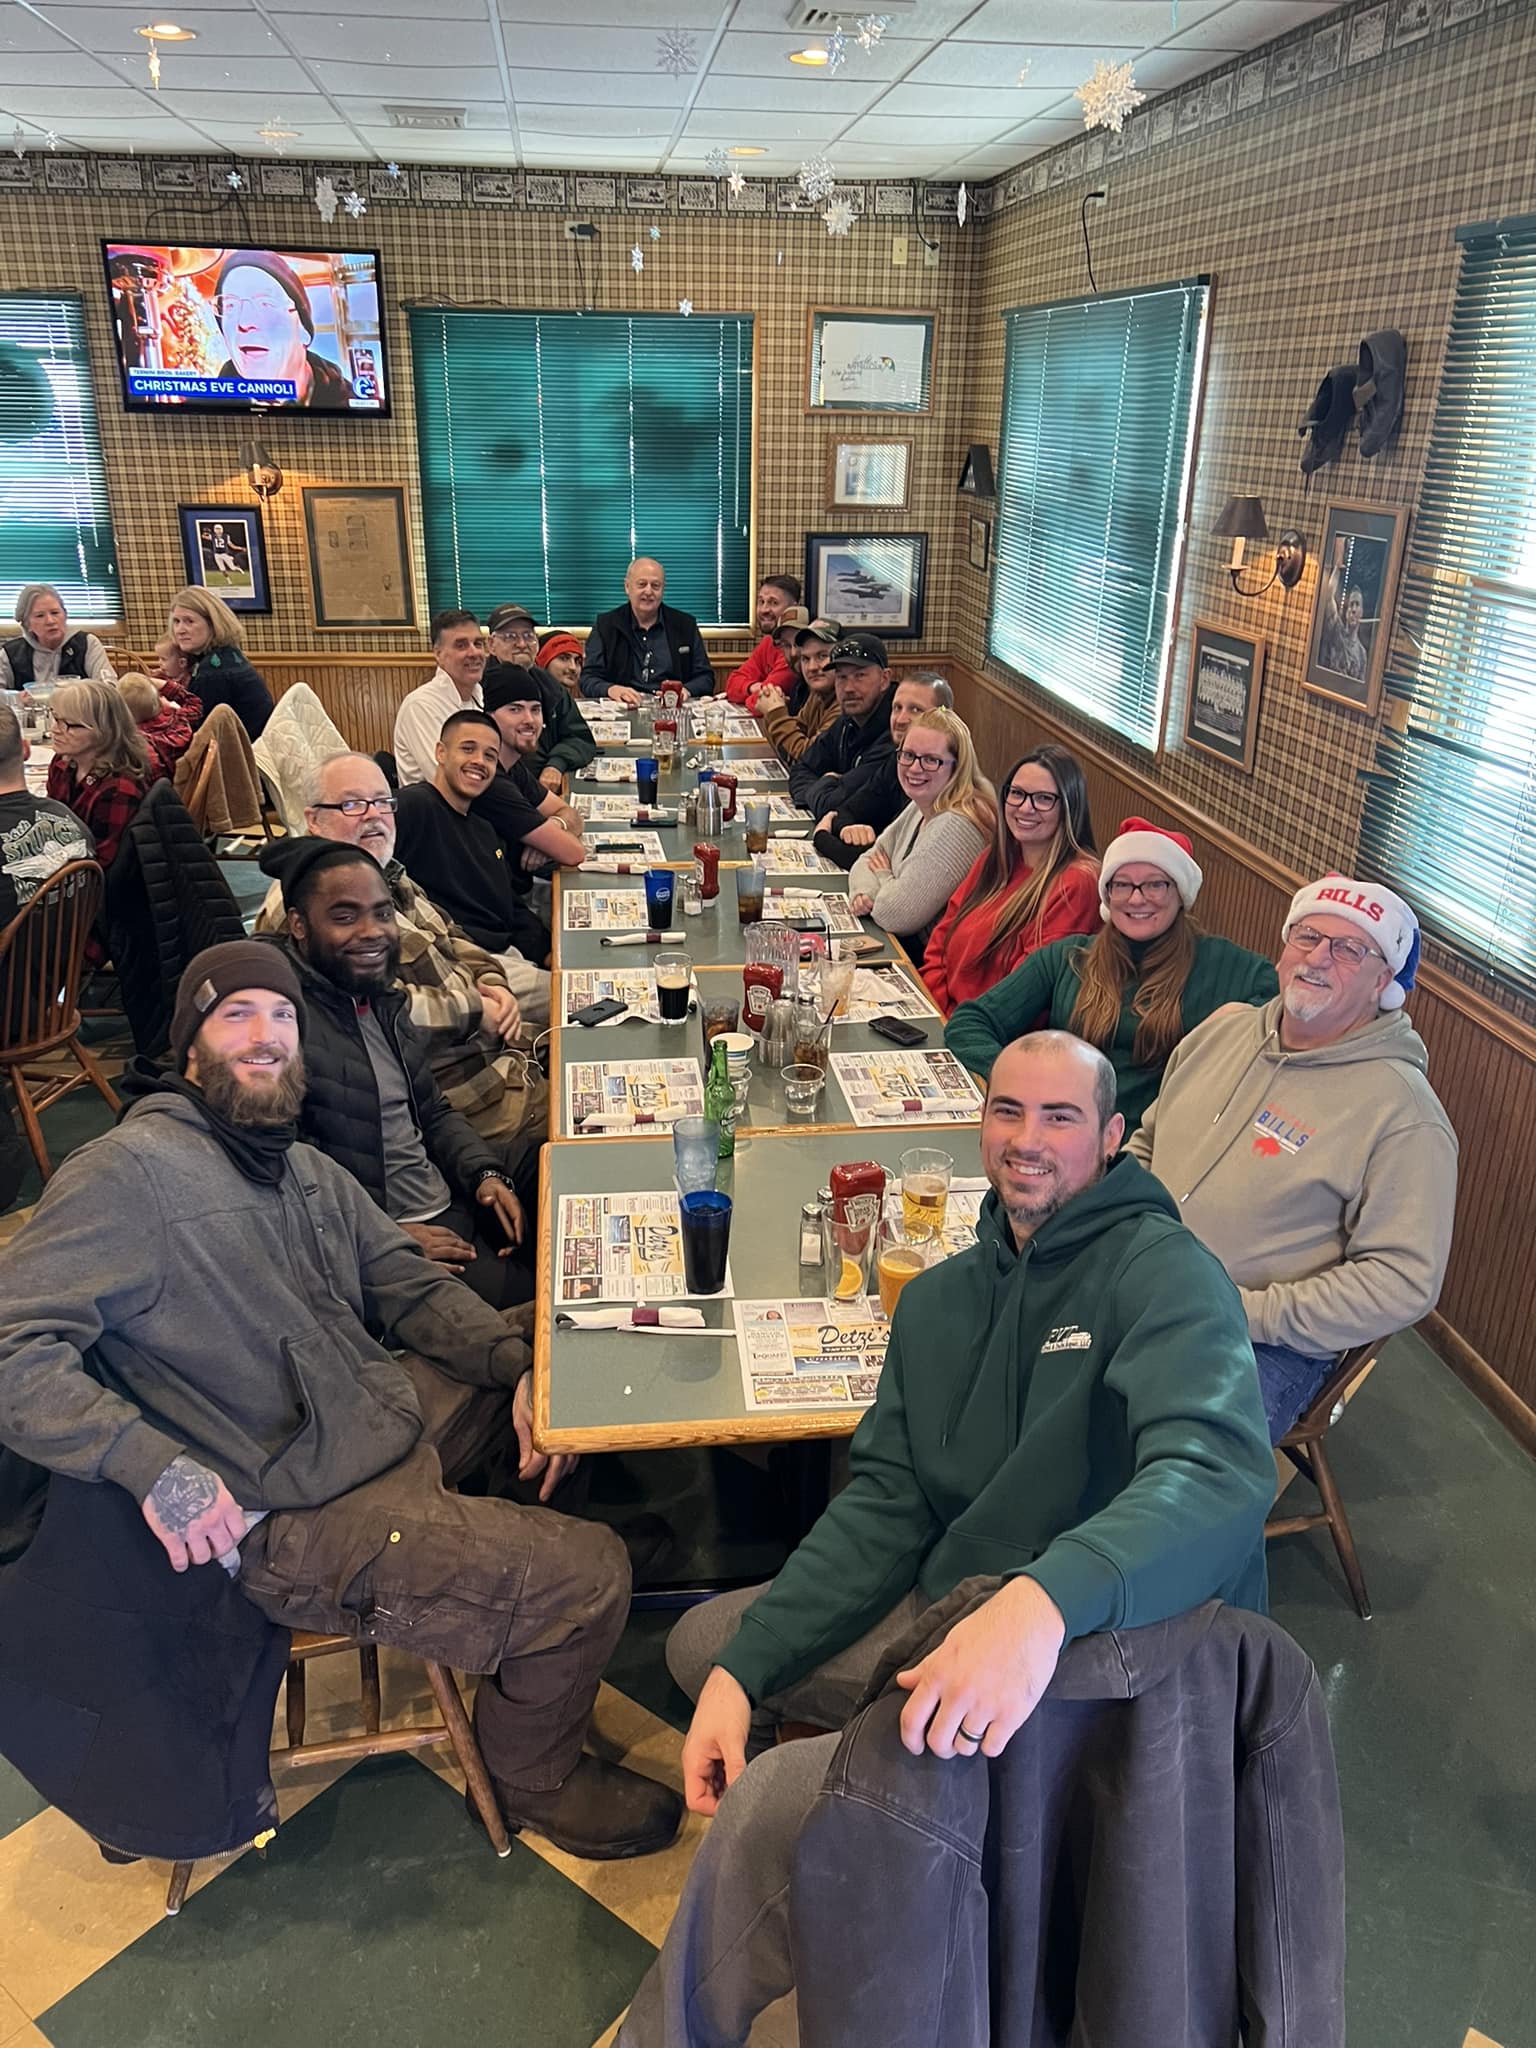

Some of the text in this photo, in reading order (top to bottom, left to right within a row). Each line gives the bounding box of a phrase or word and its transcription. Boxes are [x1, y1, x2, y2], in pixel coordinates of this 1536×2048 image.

[134, 379, 294, 395] CHRISTMAS EVE CANNOLI
[214, 538, 225, 548] 12
[1257, 1110, 1309, 1147] BILLS
